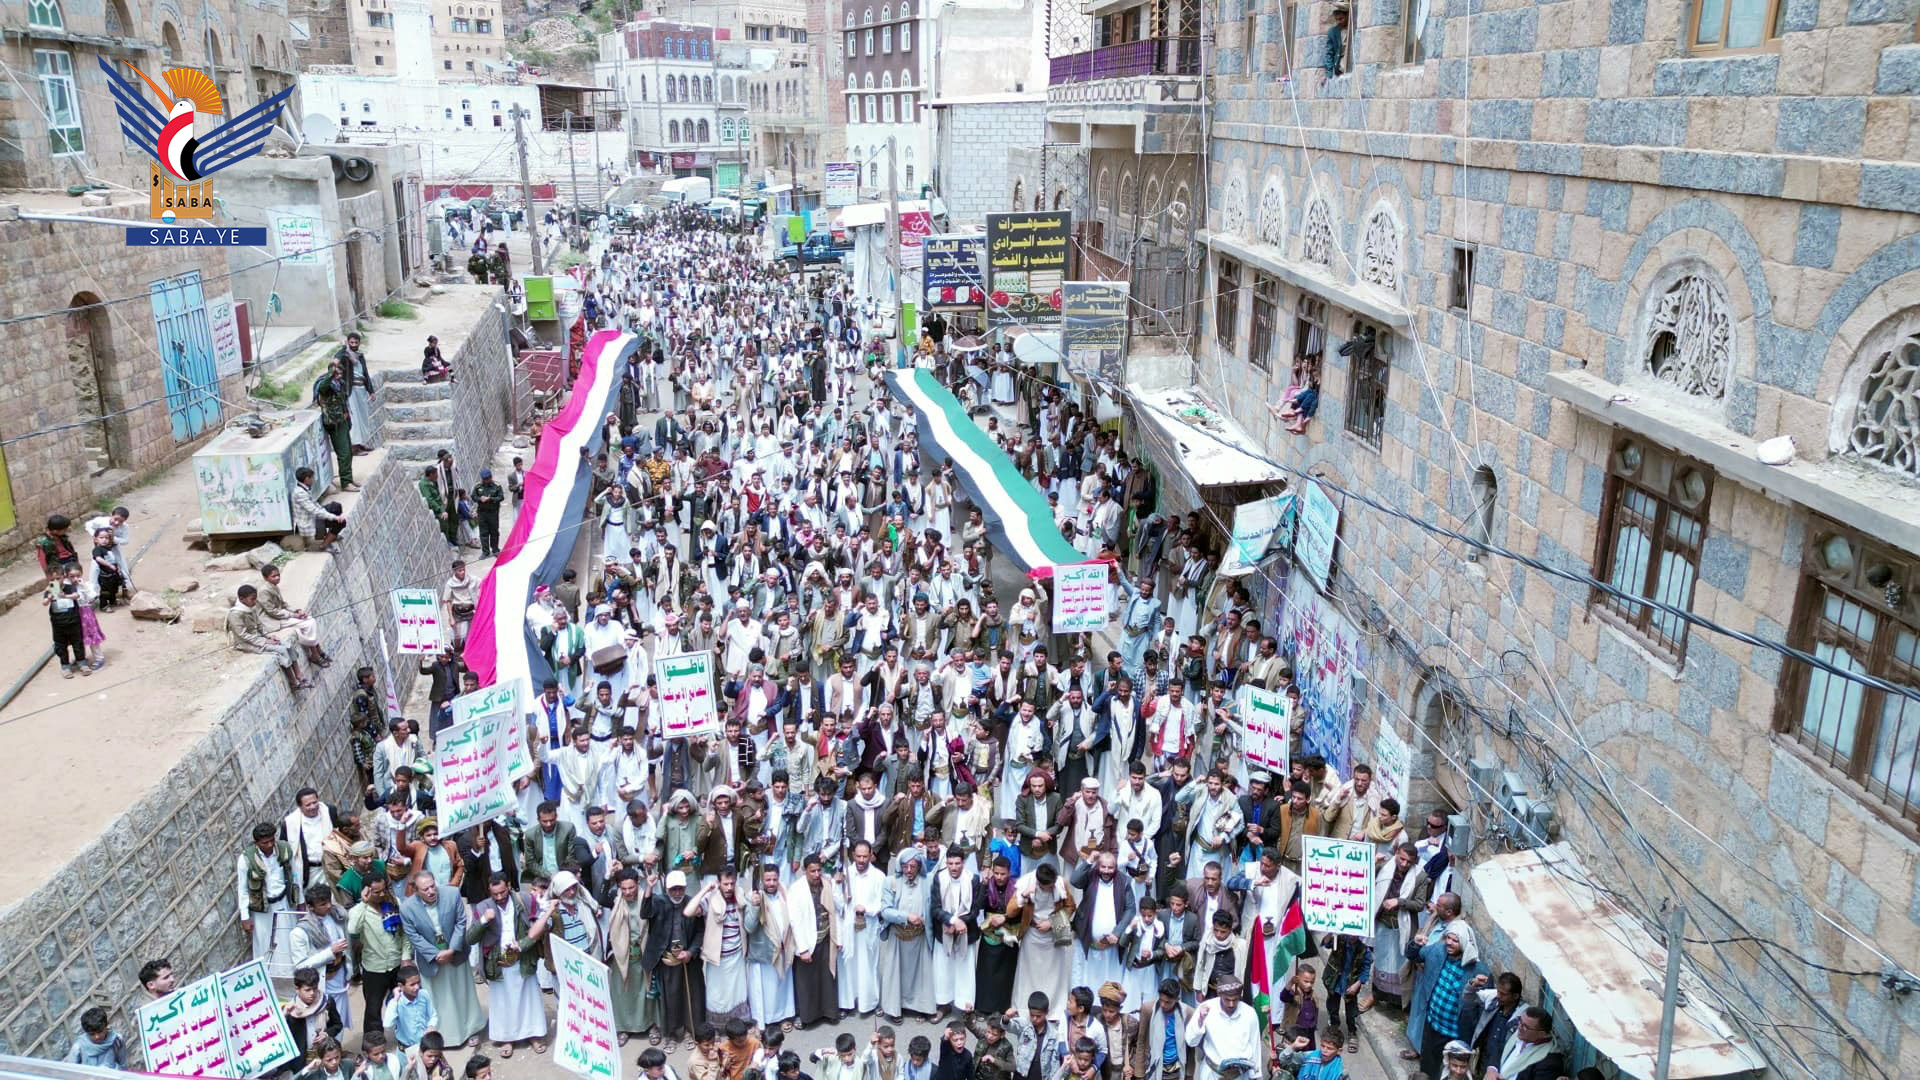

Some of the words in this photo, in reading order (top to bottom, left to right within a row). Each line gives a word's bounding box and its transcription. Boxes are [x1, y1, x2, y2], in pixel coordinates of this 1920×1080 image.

[998, 217, 1062, 232] مجوهرات
[928, 240, 959, 253] الملك
[993, 234, 1035, 250] الجرادي
[1037, 236, 1066, 247] محمد
[928, 253, 978, 270] جرادي
[992, 252, 1021, 266] الفضة
[1022, 254, 1028, 268] و
[1030, 251, 1065, 267] للذهب
[1087, 569, 1104, 578] الله
[663, 657, 705, 682] قاطعوا
[467, 689, 496, 719] أكبر
[497, 688, 515, 704] الله
[1252, 690, 1285, 717] قاطعوا
[442, 720, 480, 752] أكبر
[482, 720, 500, 738] الله
[482, 791, 507, 816] النصر
[1345, 846, 1368, 862] الله
[1341, 868, 1368, 879] الموت
[1341, 885, 1368, 896] الموت
[1307, 897, 1330, 907] اليهود
[1332, 899, 1344, 910] على
[1347, 901, 1368, 912] اللعنة
[1340, 914, 1368, 931] النصر
[233, 971, 262, 993] الله
[587, 967, 605, 991] الله
[190, 984, 216, 1008] الله
[235, 988, 268, 1013] الموت
[191, 1007, 219, 1032] الموت
[242, 1005, 274, 1030] الموت
[196, 1029, 224, 1053] الموت
[256, 1023, 282, 1044] اللعنة
[238, 1040, 253, 1057] على
[258, 1041, 290, 1073] النصر
[207, 1048, 228, 1070] اللعنة
[590, 1056, 615, 1078] النصر
